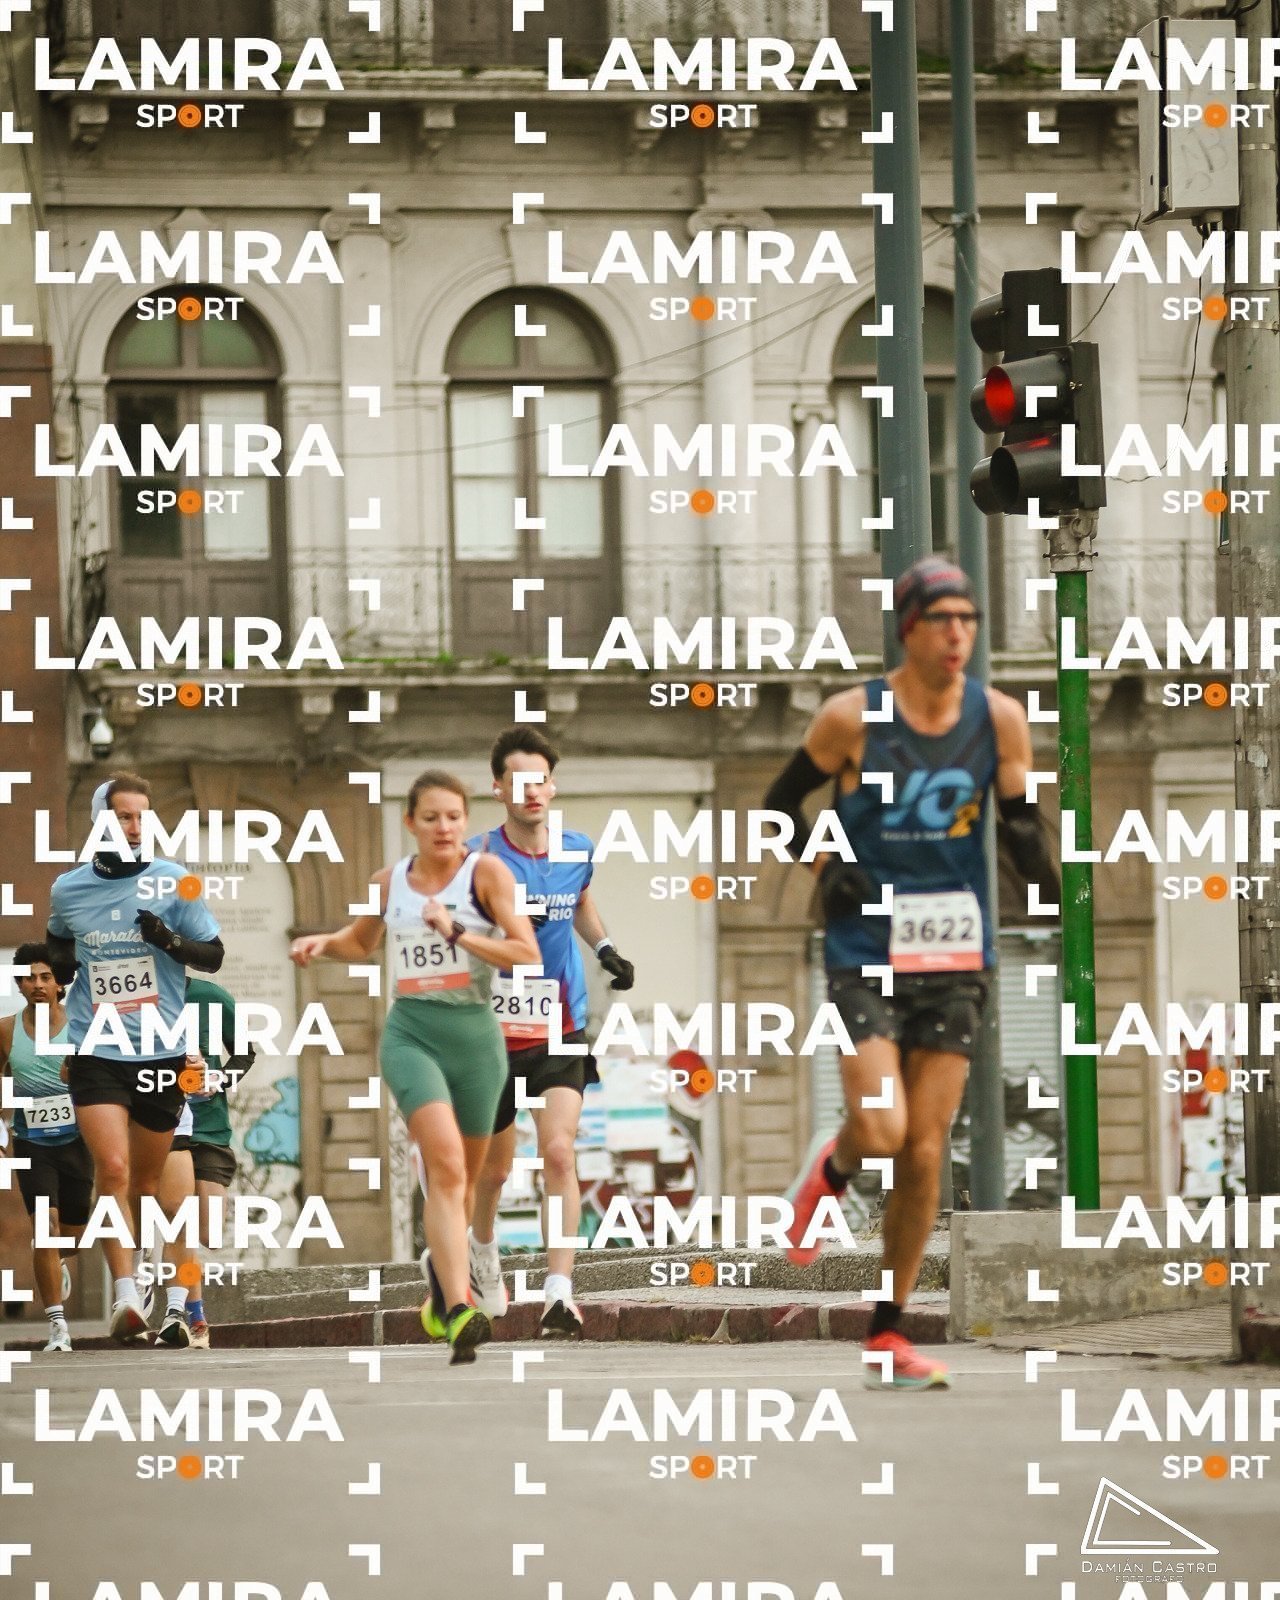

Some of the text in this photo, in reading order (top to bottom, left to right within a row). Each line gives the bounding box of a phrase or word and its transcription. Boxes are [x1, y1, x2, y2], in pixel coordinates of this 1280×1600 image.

[899, 914, 976, 944] 3622
[400, 943, 458, 969] 1851
[94, 971, 153, 996] 3664
[491, 995, 552, 1016] 2810
[27, 1106, 71, 1123] 7233
